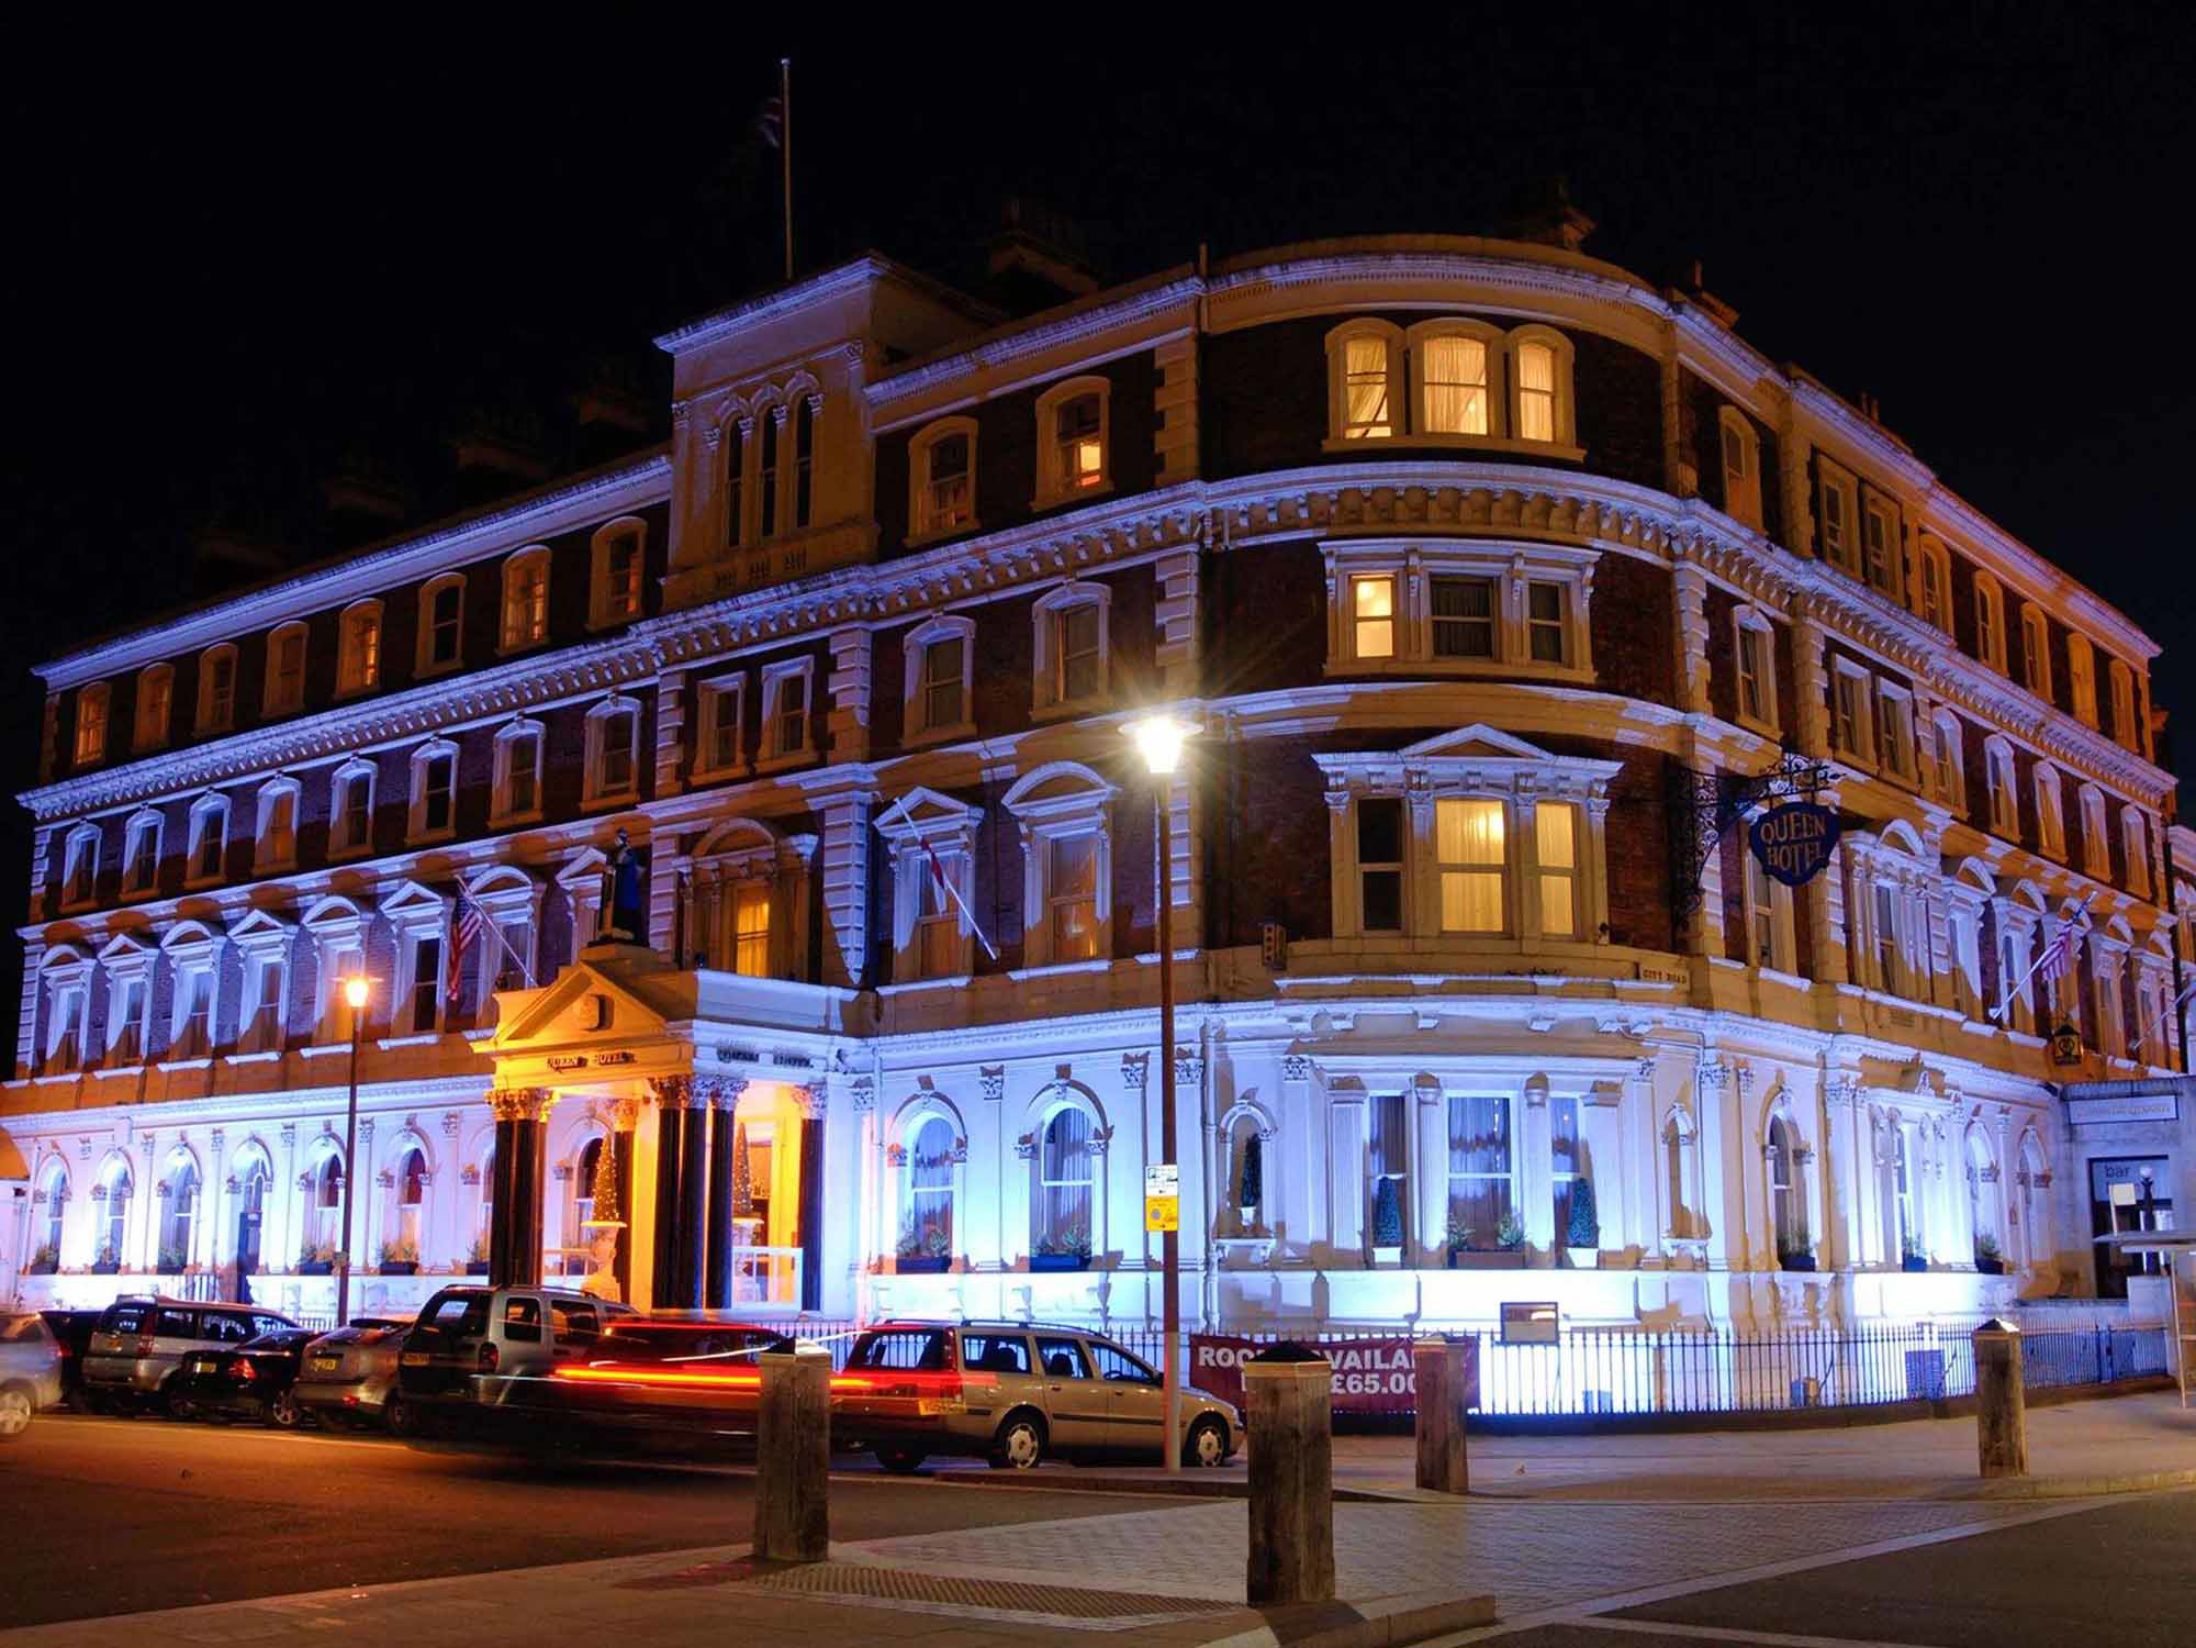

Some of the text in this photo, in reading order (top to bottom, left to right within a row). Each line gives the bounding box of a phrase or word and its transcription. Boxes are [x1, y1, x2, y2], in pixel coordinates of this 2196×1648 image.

[1760, 813, 1826, 844] QUEEN
[1767, 842, 1824, 875] HOTEL
[1200, 1346, 1415, 1369] ROO VAILA
